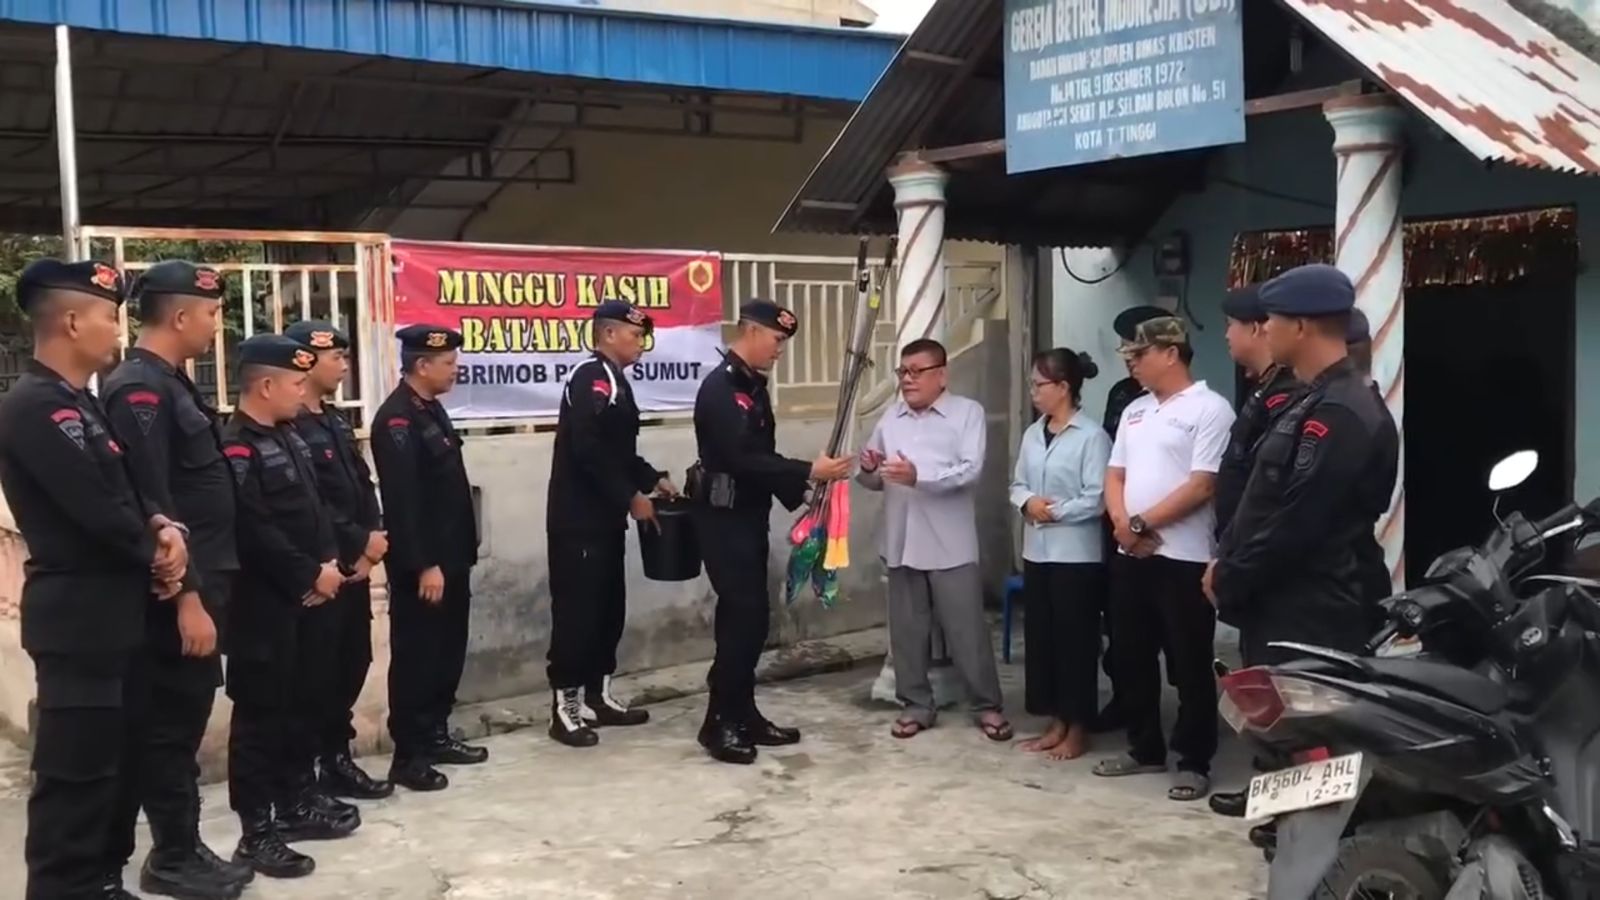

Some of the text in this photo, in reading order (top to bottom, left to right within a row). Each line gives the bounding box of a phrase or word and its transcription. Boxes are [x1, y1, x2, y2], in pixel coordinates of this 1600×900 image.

[1011, 4, 1054, 53] GEREJA
[1056, 0, 1101, 43] BETHEL
[1168, 26, 1216, 53] KRISTEN
[1102, 66, 1152, 94] DESEMBER
[1155, 60, 1184, 85] 1972
[1074, 129, 1103, 151] KOTA
[1119, 121, 1157, 145] TINGGI
[437, 269, 671, 308] MINGGU KASIH
[458, 362, 547, 385] BRIMOB
[632, 361, 702, 382] SUMUT
[1322, 758, 1355, 781] AHL
